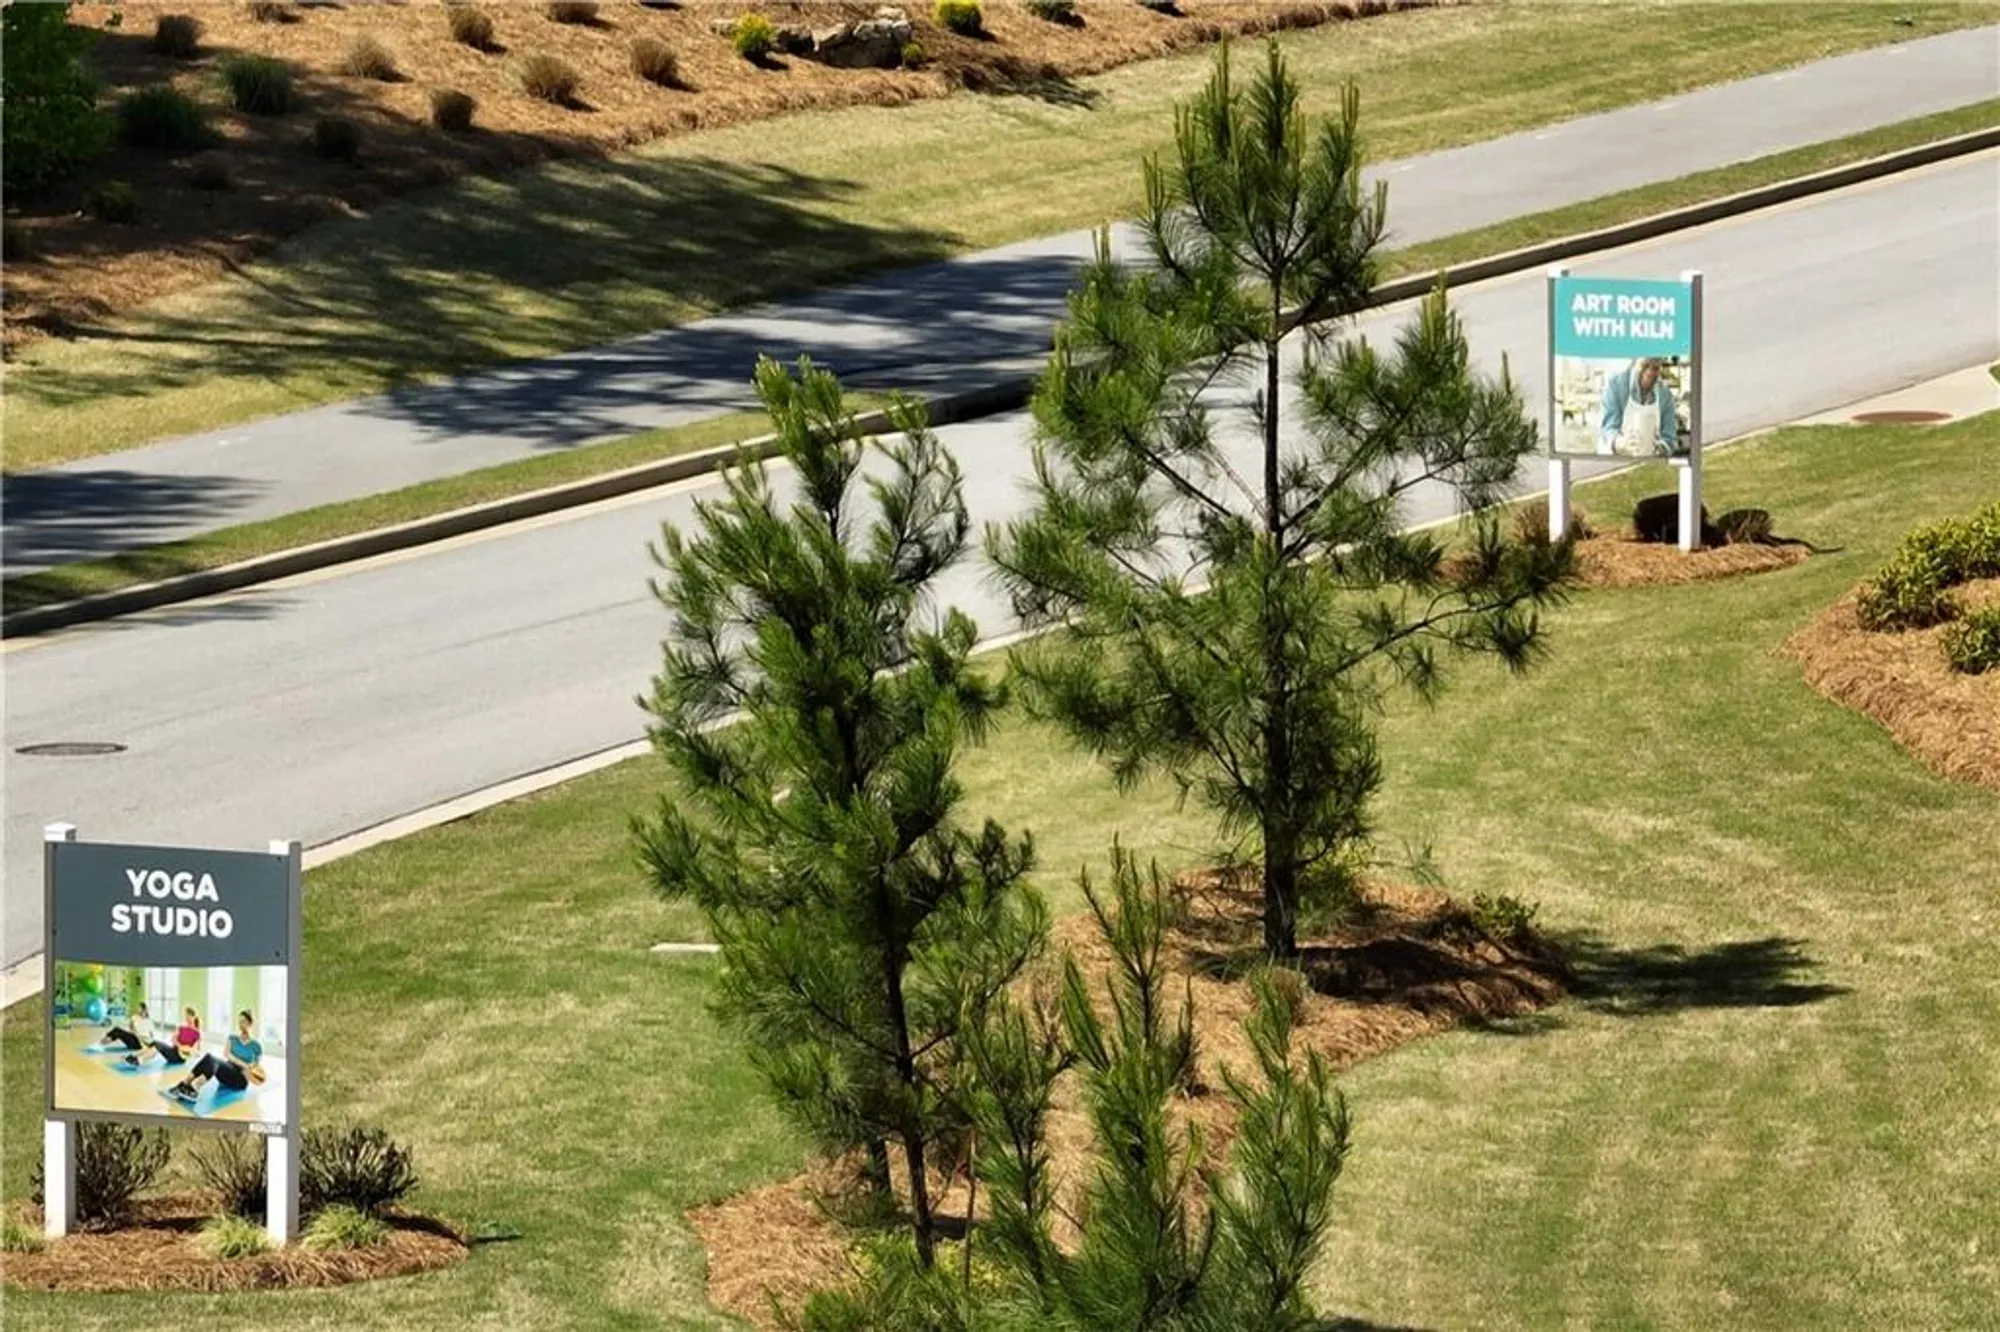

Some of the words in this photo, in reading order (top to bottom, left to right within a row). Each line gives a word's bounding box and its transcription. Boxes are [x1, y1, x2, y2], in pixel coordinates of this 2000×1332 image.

[1572, 293, 1612, 313] ART
[1617, 295, 1675, 315] ROOM
[1574, 318, 1625, 337] WITH
[1630, 319, 1674, 339] KILN
[126, 869, 219, 902] YOGA
[111, 904, 233, 939] STUDIO
